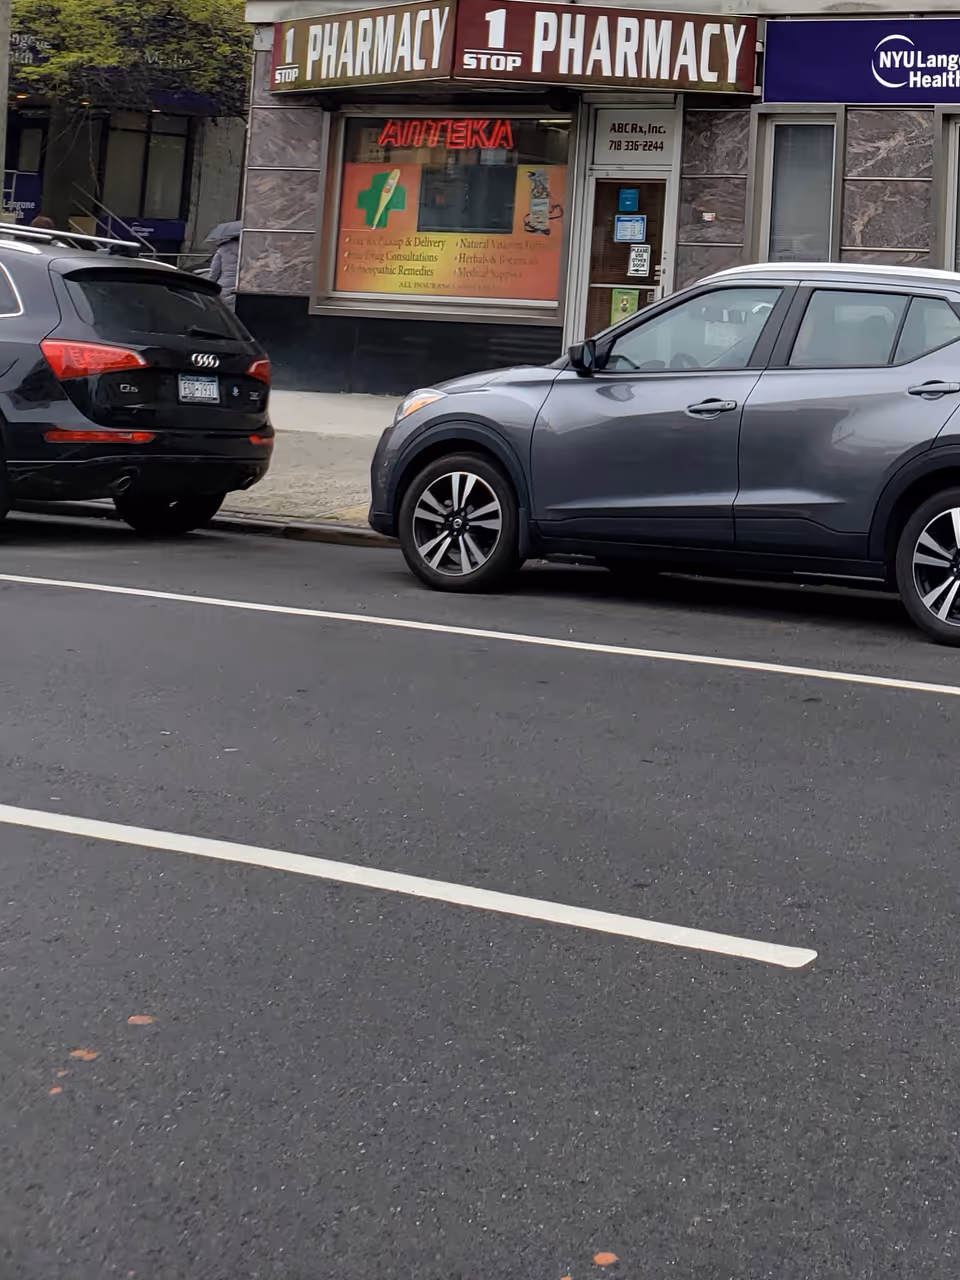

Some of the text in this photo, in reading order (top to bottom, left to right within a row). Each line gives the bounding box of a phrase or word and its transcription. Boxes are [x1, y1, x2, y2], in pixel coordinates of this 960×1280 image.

[285, 6, 450, 81] 1 PHARMACY
[485, 9, 747, 84] 1 PHARMACY
[463, 54, 522, 71] STOP
[880, 51, 915, 68] NYU
[275, 69, 299, 84] STOP
[609, 122, 629, 134] ABC
[648, 123, 666, 134] Inc.
[609, 140, 664, 151] 718 336-2244
[413, 236, 447, 251] Delivery
[386, 250, 438, 263] Consultations
[398, 264, 434, 277] Remedies
